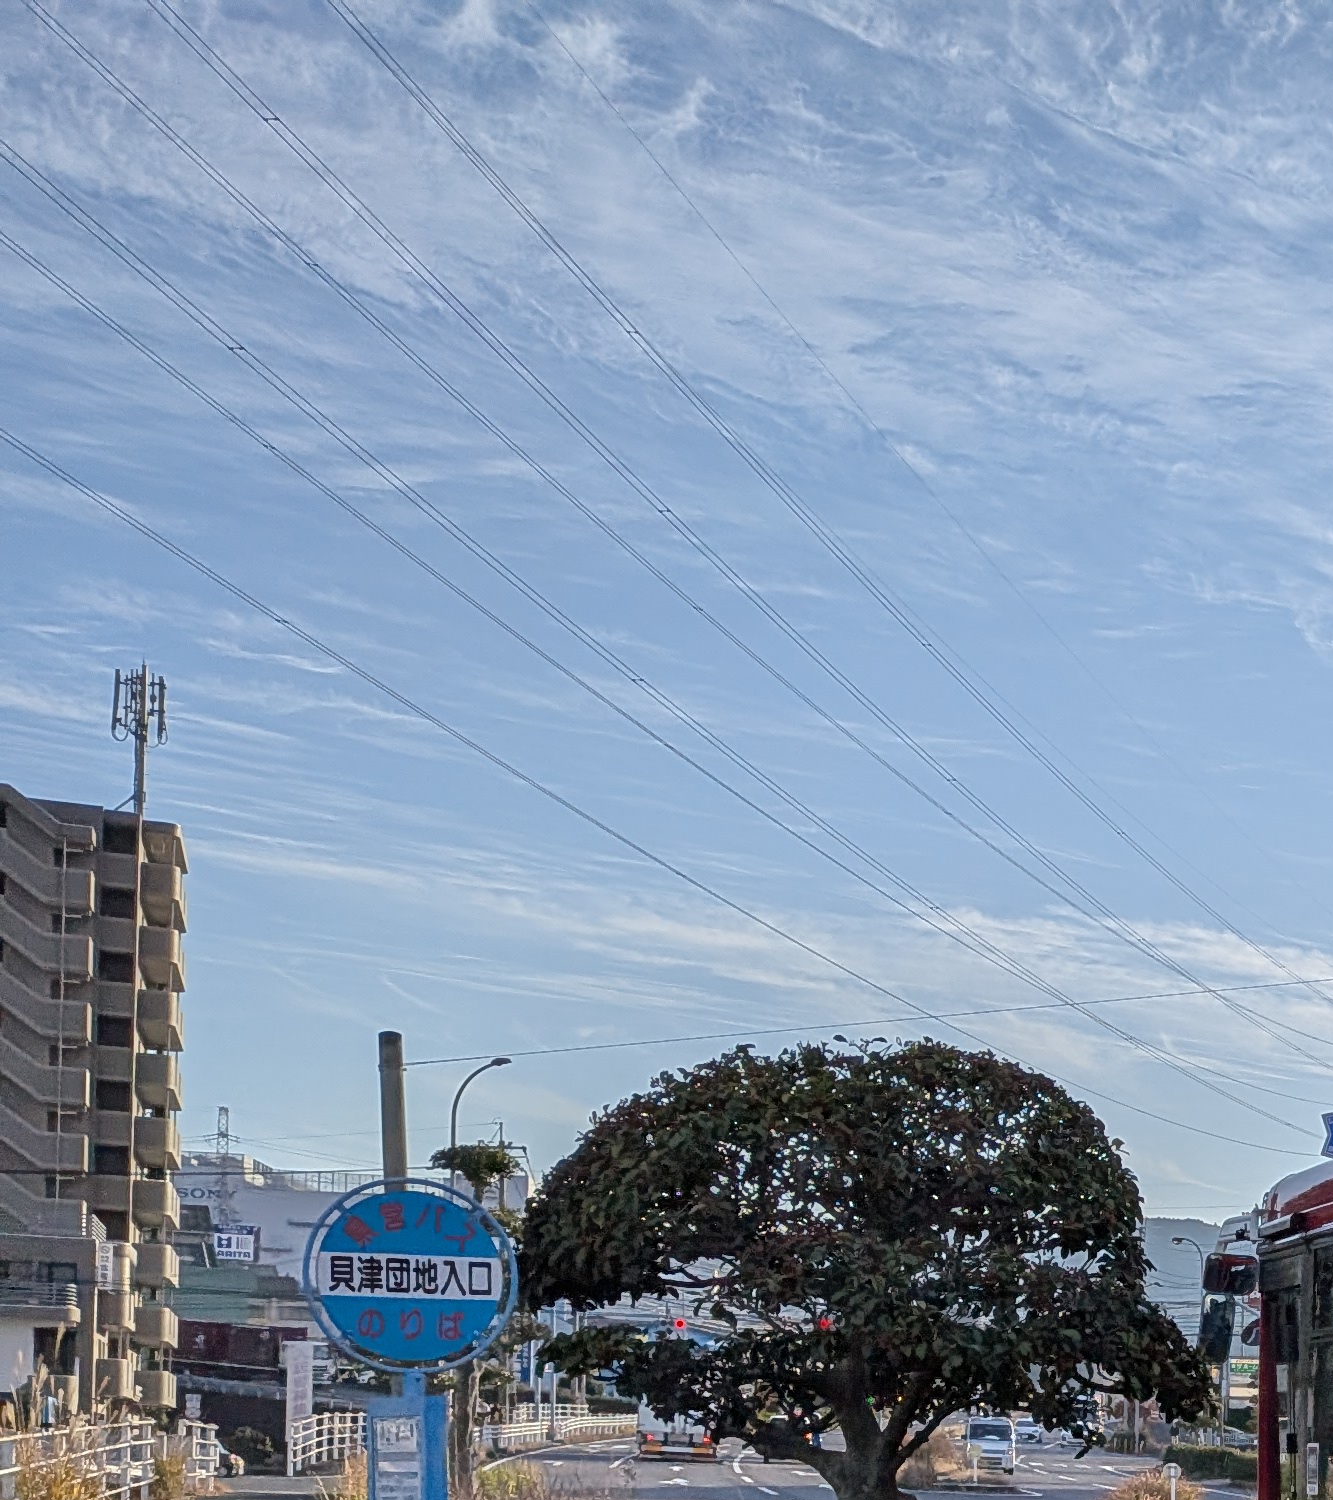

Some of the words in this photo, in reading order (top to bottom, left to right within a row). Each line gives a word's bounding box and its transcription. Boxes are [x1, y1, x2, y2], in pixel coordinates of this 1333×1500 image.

[328, 1255, 493, 1297] 貝津団地入口
[358, 1308, 464, 1340] のりば
